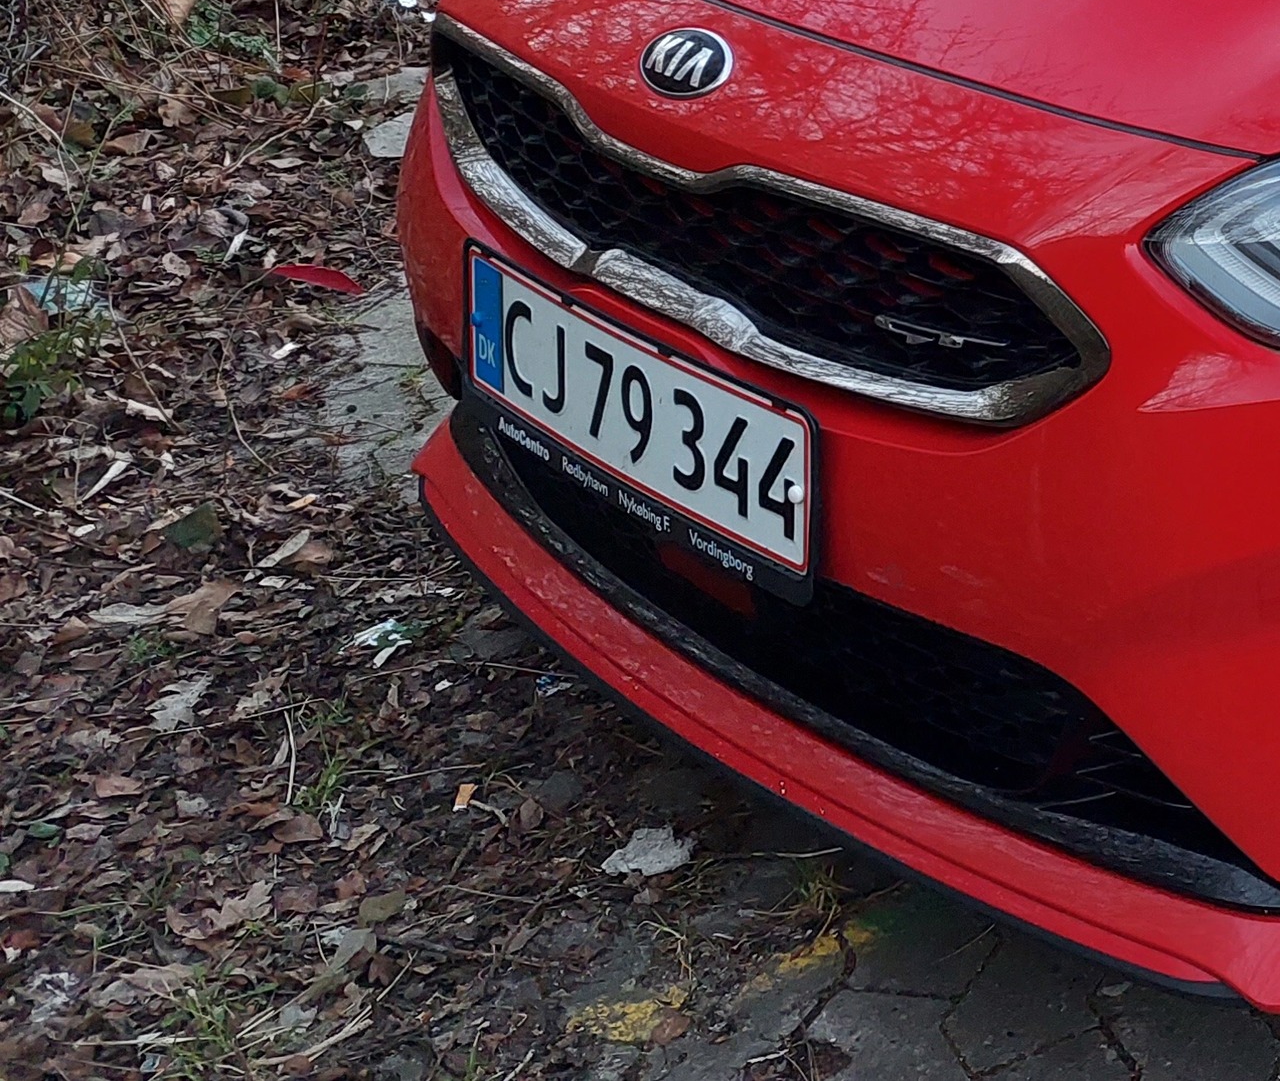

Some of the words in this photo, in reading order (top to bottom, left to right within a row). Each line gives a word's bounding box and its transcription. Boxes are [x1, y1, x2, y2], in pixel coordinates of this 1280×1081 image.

[645, 34, 714, 88] KIA
[478, 333, 496, 369] DK
[505, 300, 566, 414] CJ
[585, 341, 653, 464] 79
[672, 388, 796, 540] 344
[689, 529, 754, 581] Vordingborg
